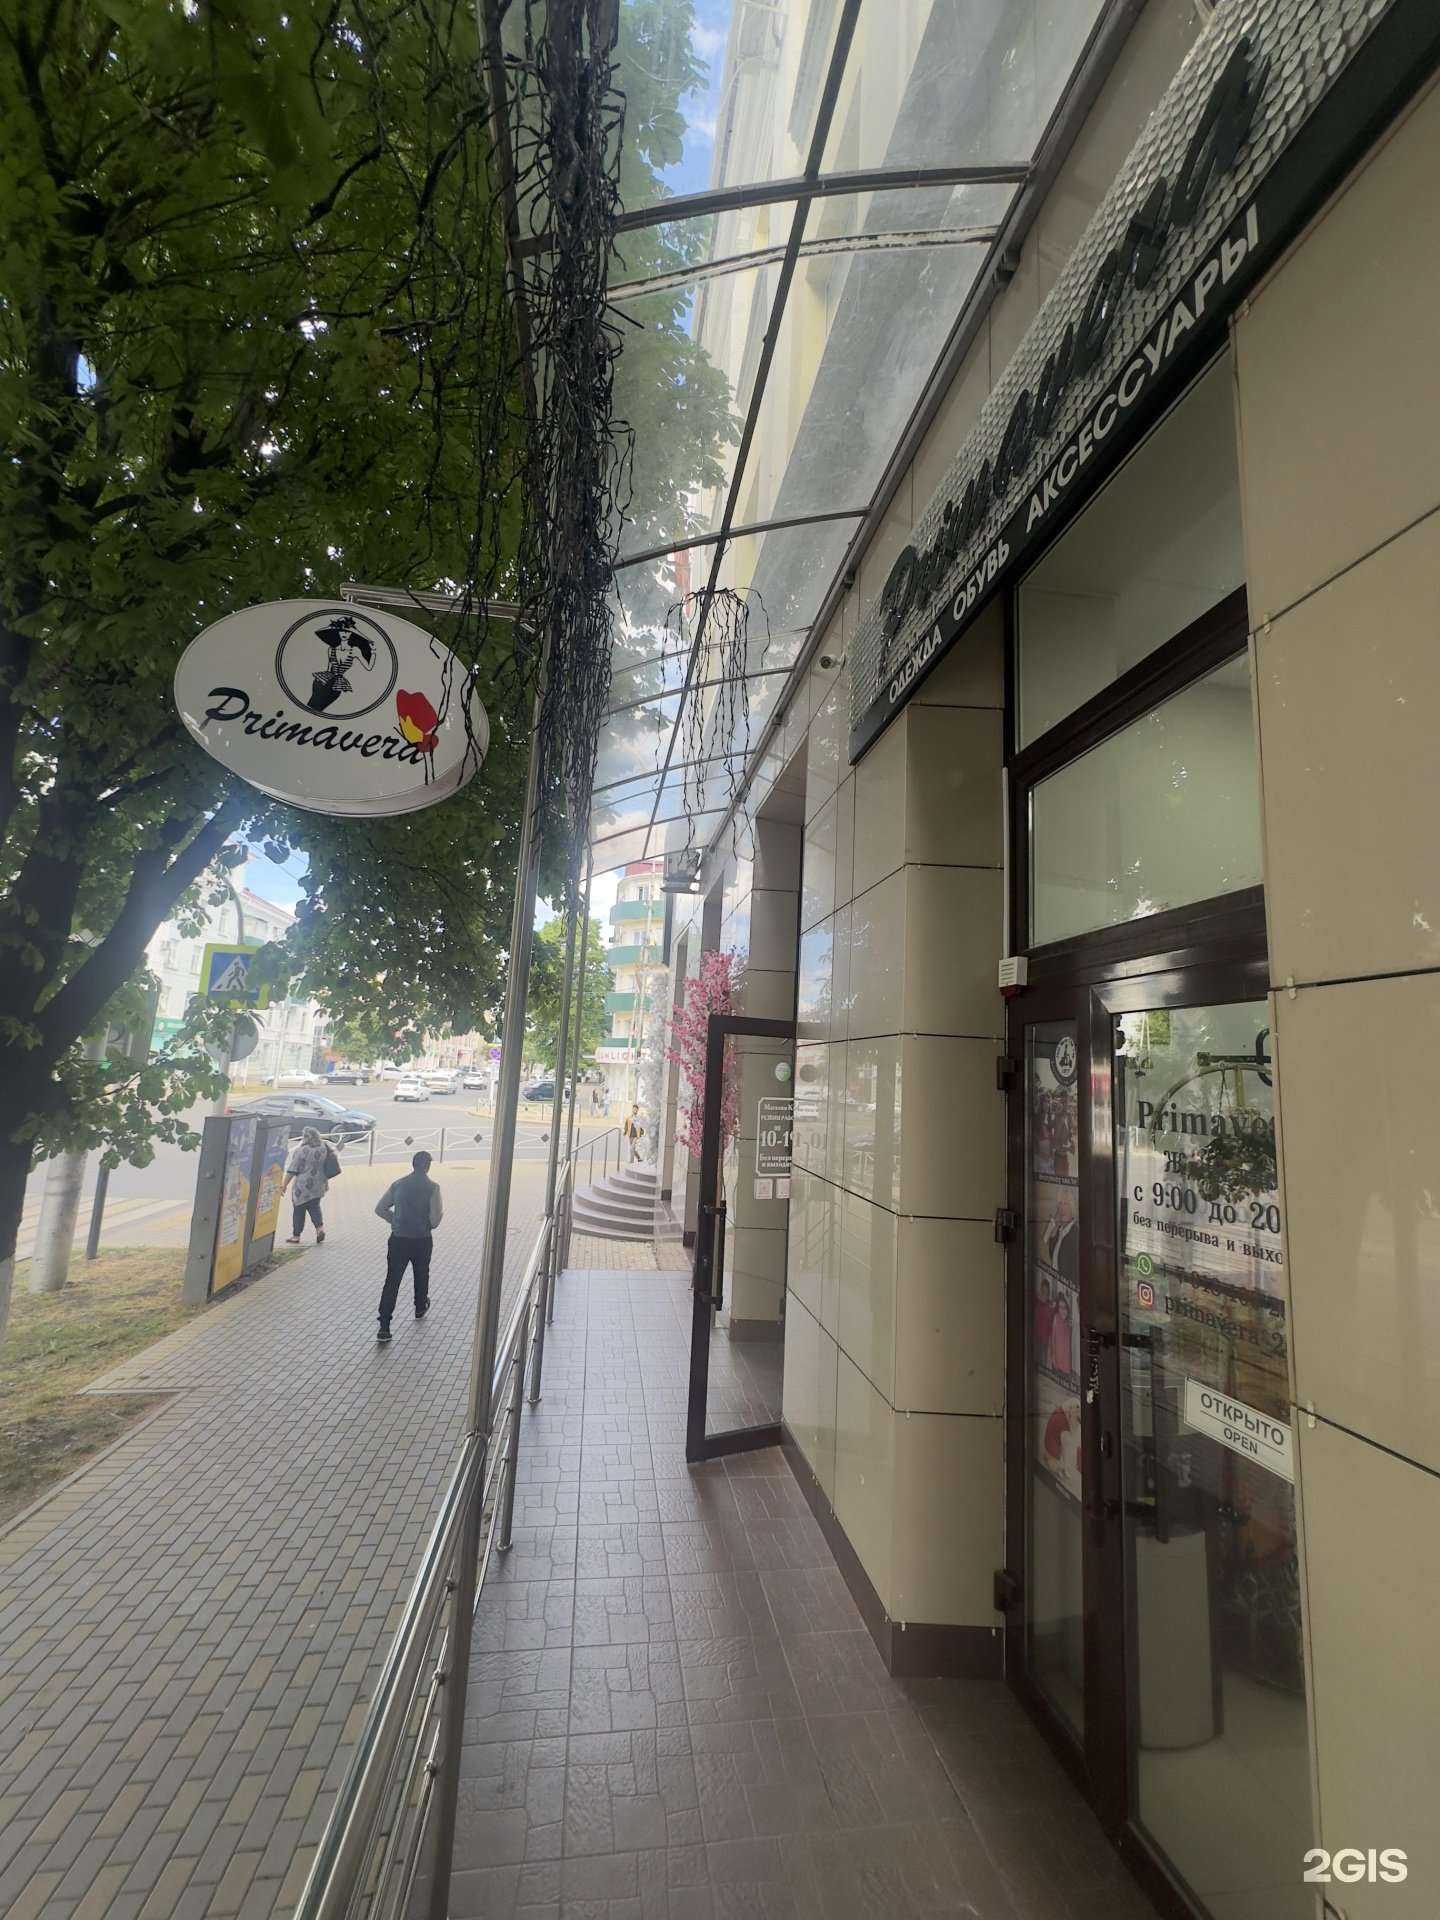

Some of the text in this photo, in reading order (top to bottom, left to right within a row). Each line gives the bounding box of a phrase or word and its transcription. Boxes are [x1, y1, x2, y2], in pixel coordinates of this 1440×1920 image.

[889, 204, 1259, 703] ОДЕЖДА ОБУВЬ АКСЕССУАРЫ
[200, 687, 424, 765] Primavera
[1134, 1185, 1144, 1202] с
[1152, 1182, 1197, 1215] 9:00
[1208, 1202, 1237, 1226] до
[1133, 1211, 1152, 1229] без
[1157, 1219, 1219, 1249] перерыва
[1226, 1239, 1236, 1252] и
[1200, 1393, 1284, 1446] ОТКРЫТО
[1223, 1427, 1258, 1454] OPEN
